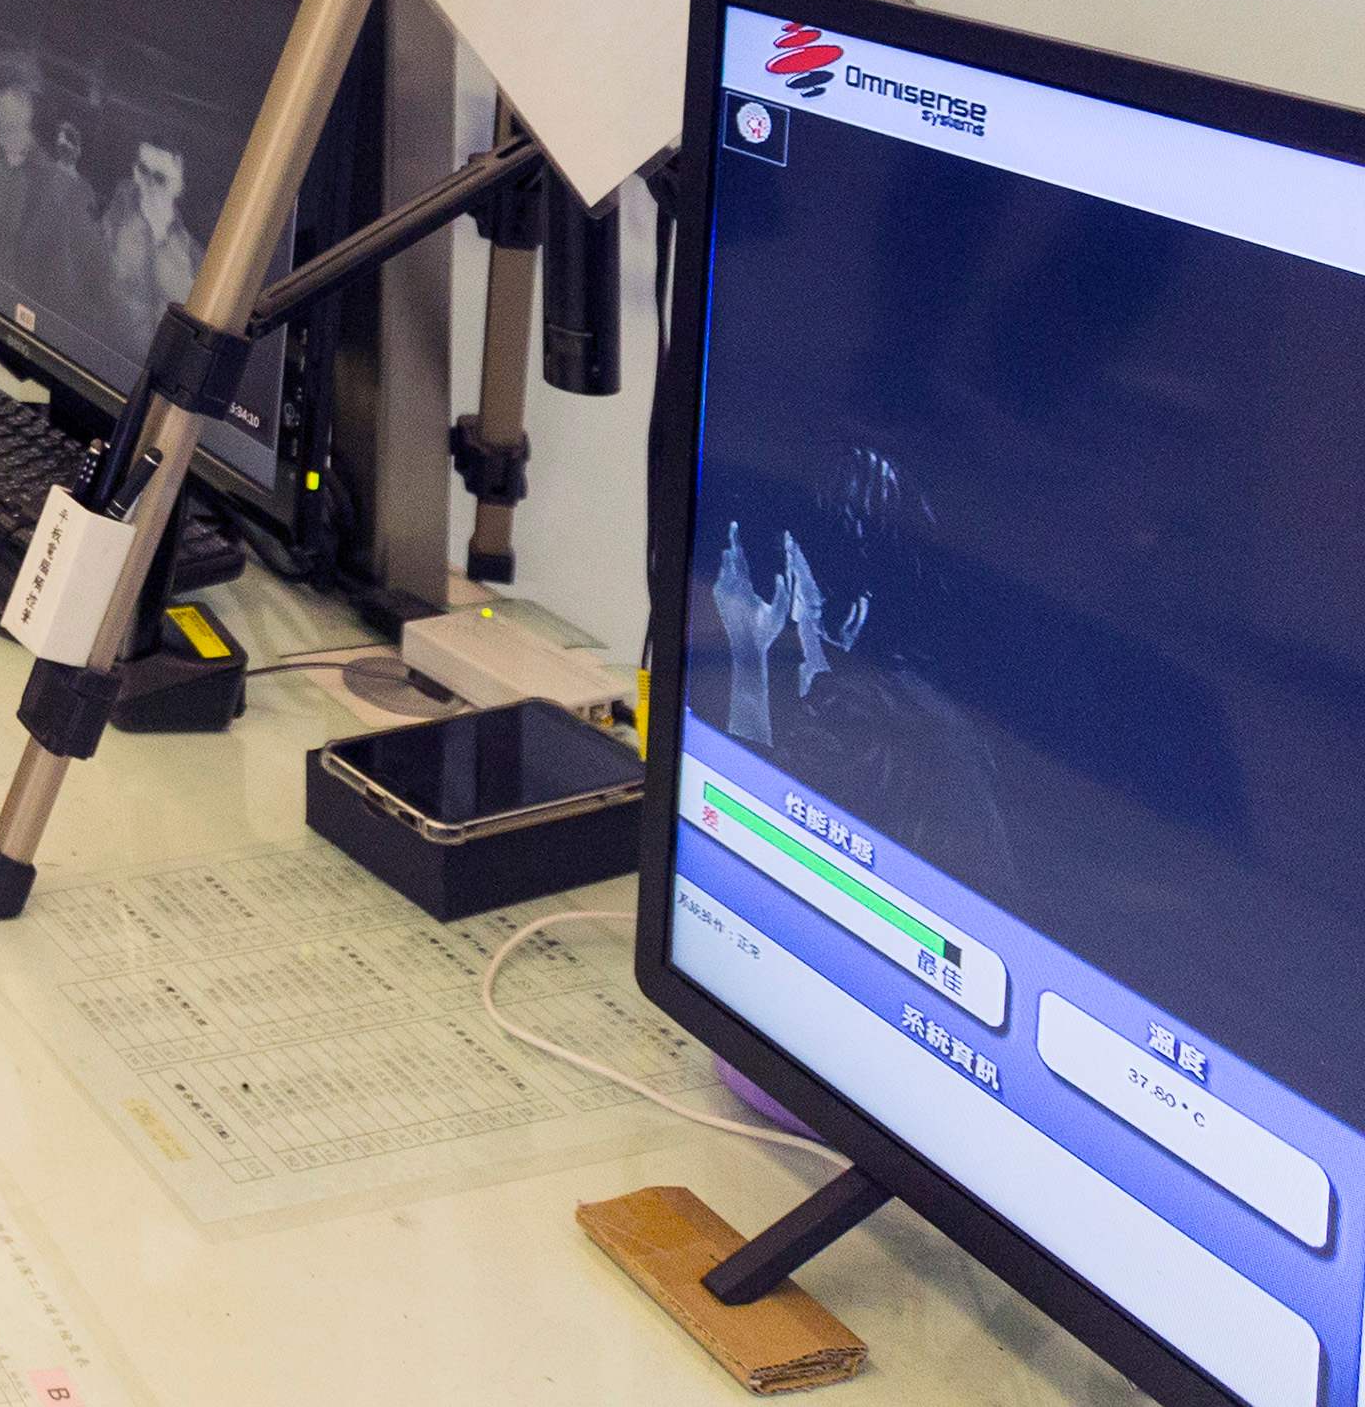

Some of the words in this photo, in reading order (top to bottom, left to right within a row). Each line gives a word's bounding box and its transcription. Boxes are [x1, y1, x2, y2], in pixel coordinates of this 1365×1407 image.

[845, 65, 987, 122] Omnisense
[921, 109, 985, 137] systems
[784, 791, 875, 866] 性能狀態
[918, 948, 963, 997] 最佳
[900, 1002, 1001, 1092] 系統資訊
[1148, 1021, 1207, 1083] 溫度
